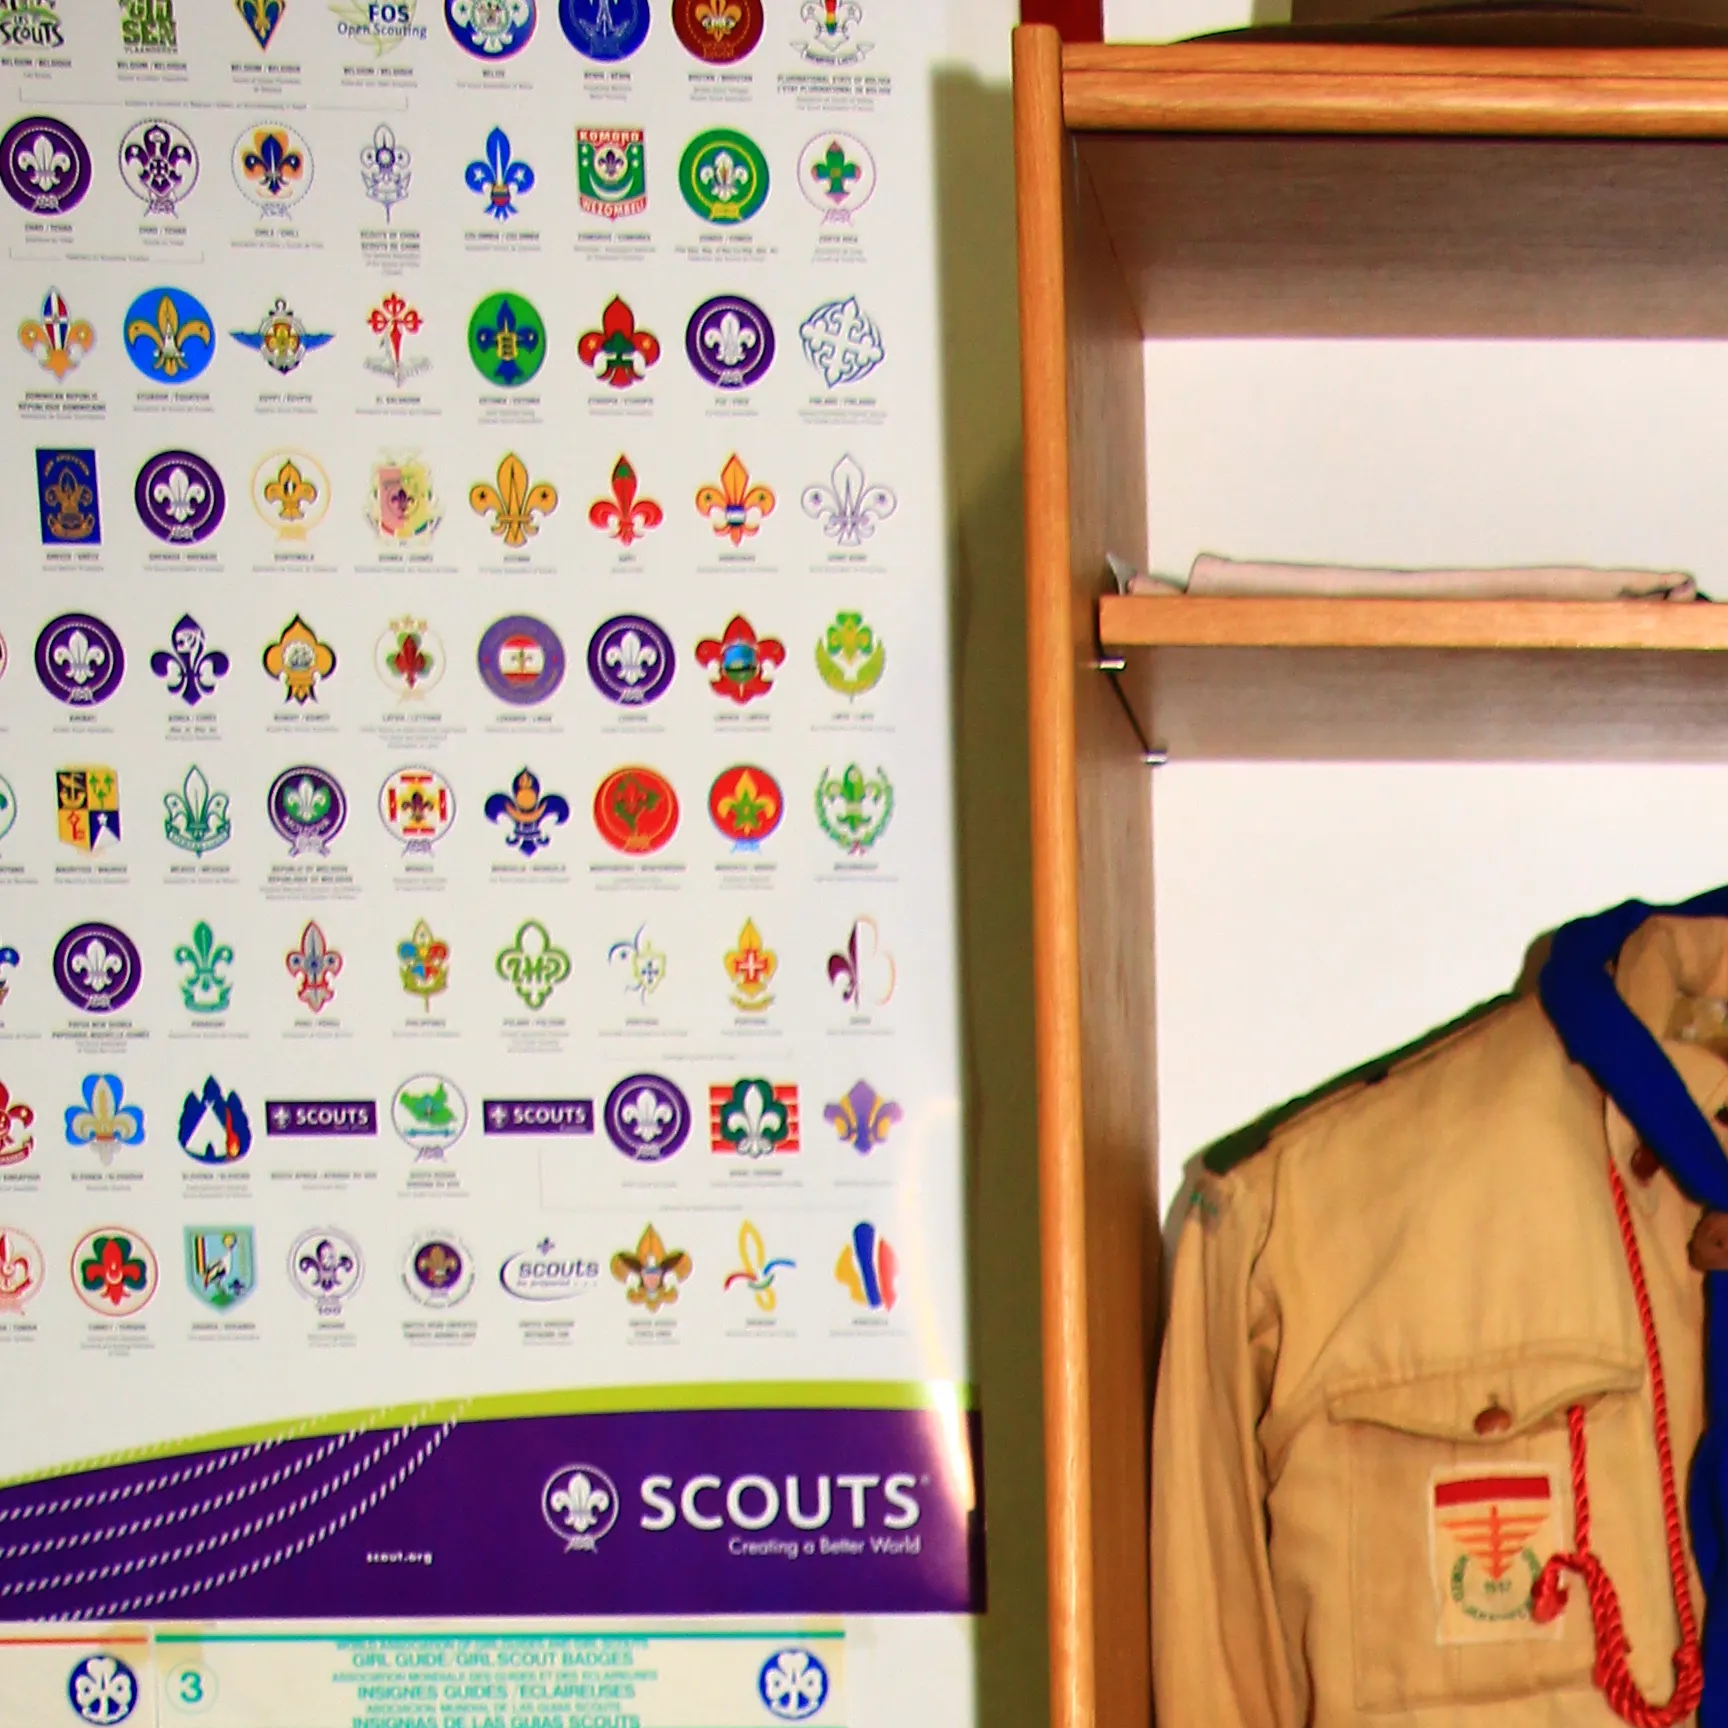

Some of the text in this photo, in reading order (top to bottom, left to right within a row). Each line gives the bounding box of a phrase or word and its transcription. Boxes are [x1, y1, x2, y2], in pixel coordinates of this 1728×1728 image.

[368, 4, 410, 24] FOS
[0, 22, 64, 47] SCOUTS
[337, 23, 428, 40] Open Scouting
[296, 1107, 368, 1126] SCOUTS
[513, 1106, 586, 1125] SCOUTS
[519, 1258, 600, 1279] scouts
[640, 1473, 921, 1531] SCOUTS
[728, 1535, 922, 1560] Creating a Better World
[366, 1550, 433, 1566] scout.org
[352, 1653, 388, 1667] GIRL
[497, 1651, 559, 1666] SCOUT
[562, 1651, 634, 1666] BADGES
[179, 1670, 204, 1703] 3
